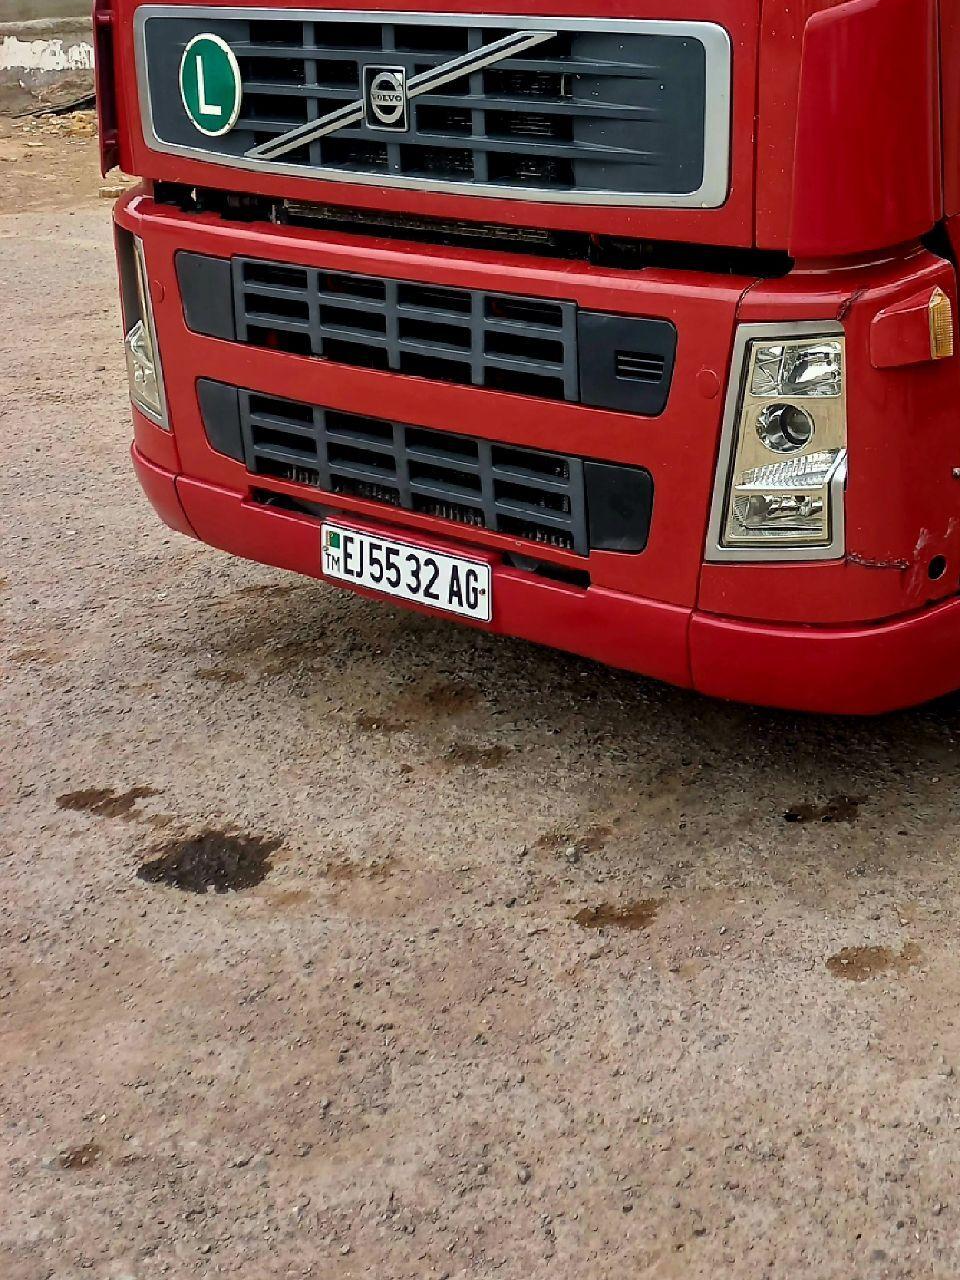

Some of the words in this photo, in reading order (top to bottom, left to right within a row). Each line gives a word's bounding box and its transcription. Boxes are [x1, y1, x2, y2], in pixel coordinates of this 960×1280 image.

[195, 55, 222, 117] L
[371, 93, 403, 103] VOLVO
[325, 552, 341, 572] TM
